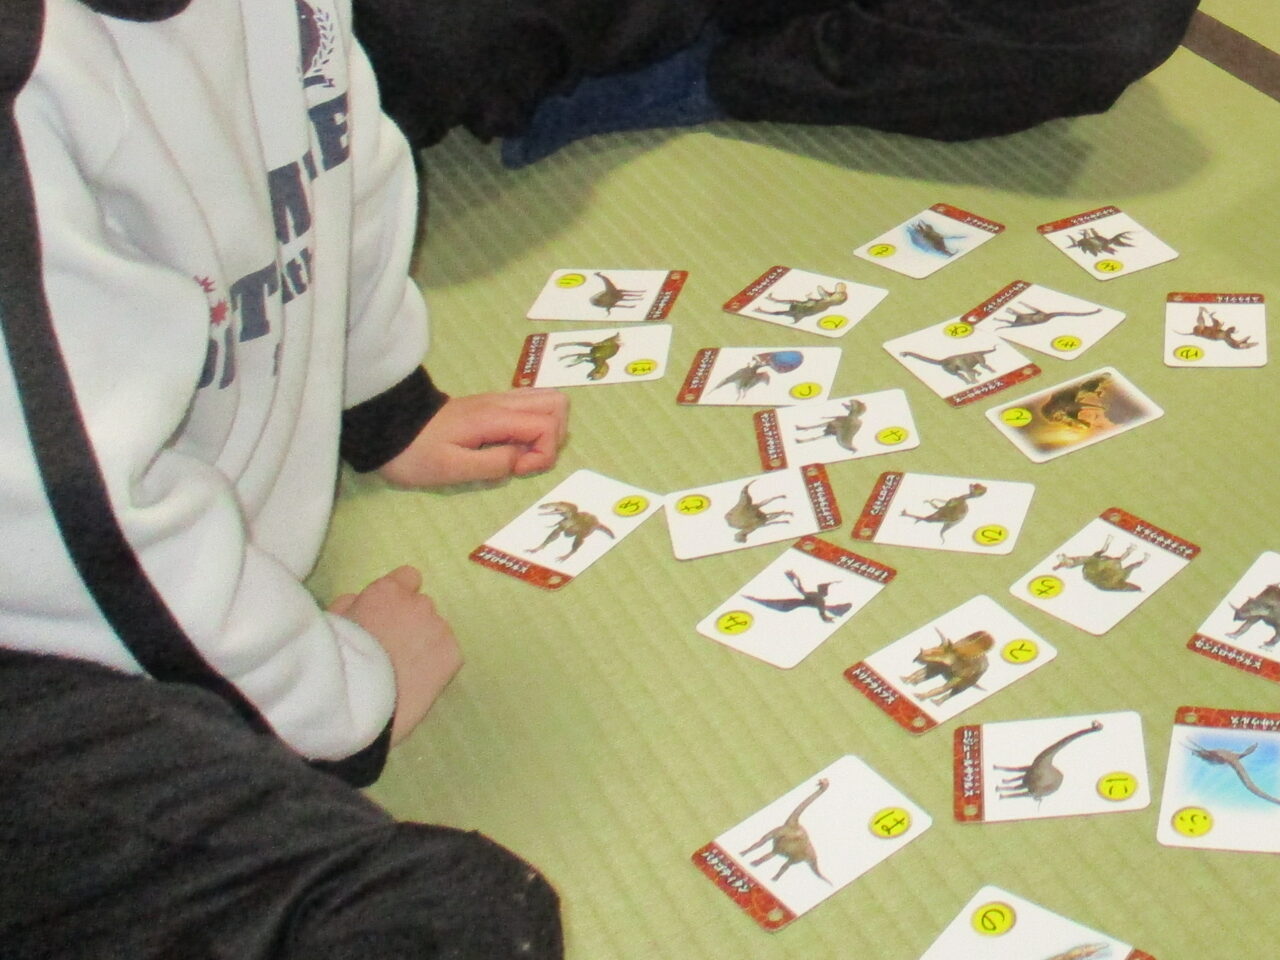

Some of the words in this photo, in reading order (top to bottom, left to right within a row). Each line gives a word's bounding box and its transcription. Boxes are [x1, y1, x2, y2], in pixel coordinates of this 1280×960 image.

[874, 245, 890, 256] も
[950, 324, 971, 336] ぬ
[1179, 348, 1199, 359] ゆ
[798, 384, 813, 397] つ
[882, 429, 903, 442] や
[813, 480, 834, 526] ムッタブラサウルス
[869, 475, 895, 515] ヒプシロフォドン
[618, 500, 640, 513] め
[681, 499, 704, 512] む
[980, 529, 1003, 543] ひ
[837, 553, 889, 579] ミクロラプトル
[1036, 579, 1055, 596] ち
[723, 615, 748, 631] み
[1008, 642, 1032, 661] と
[1191, 639, 1264, 670] セントロサウルス
[850, 668, 896, 704] トリケラトプス
[963, 729, 973, 797] ニジェールサウルス
[1105, 777, 1129, 796] に
[873, 810, 905, 835] は
[1179, 813, 1208, 833] ふ
[698, 849, 752, 895] パタゴティタン
[980, 908, 1006, 932] の
